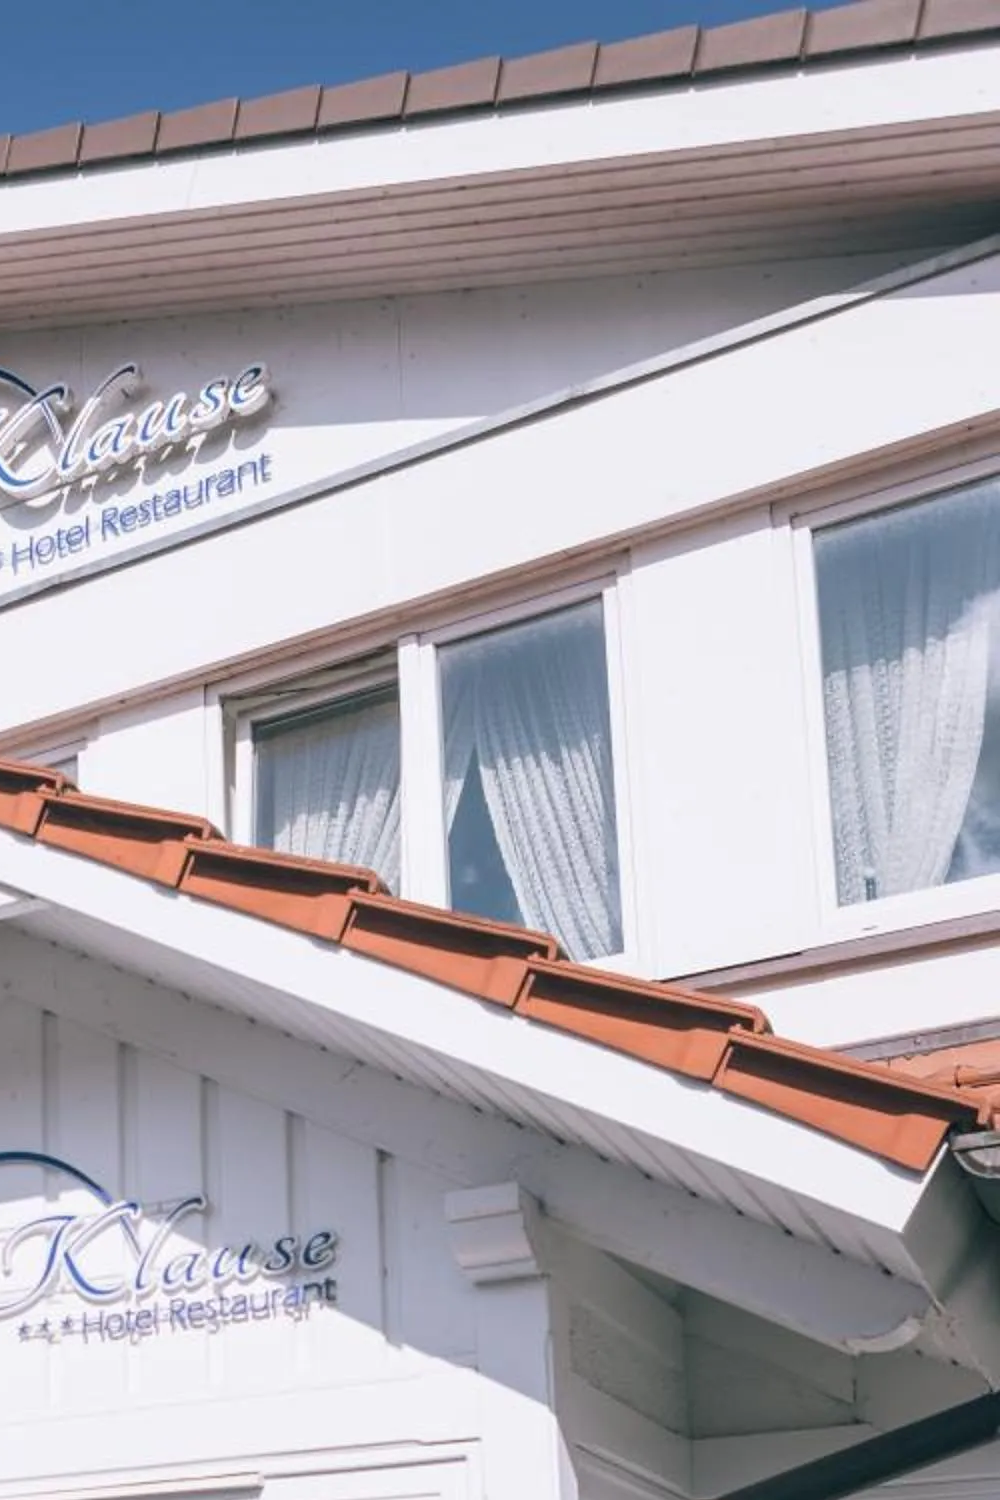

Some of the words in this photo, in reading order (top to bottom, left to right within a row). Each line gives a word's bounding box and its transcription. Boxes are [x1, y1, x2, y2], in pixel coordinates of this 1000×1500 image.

[10, 516, 92, 575] Hotel
[99, 453, 273, 543] Restaurant
[83, 1305, 160, 1344] Hotel
[170, 1277, 338, 1333] Restaurant
